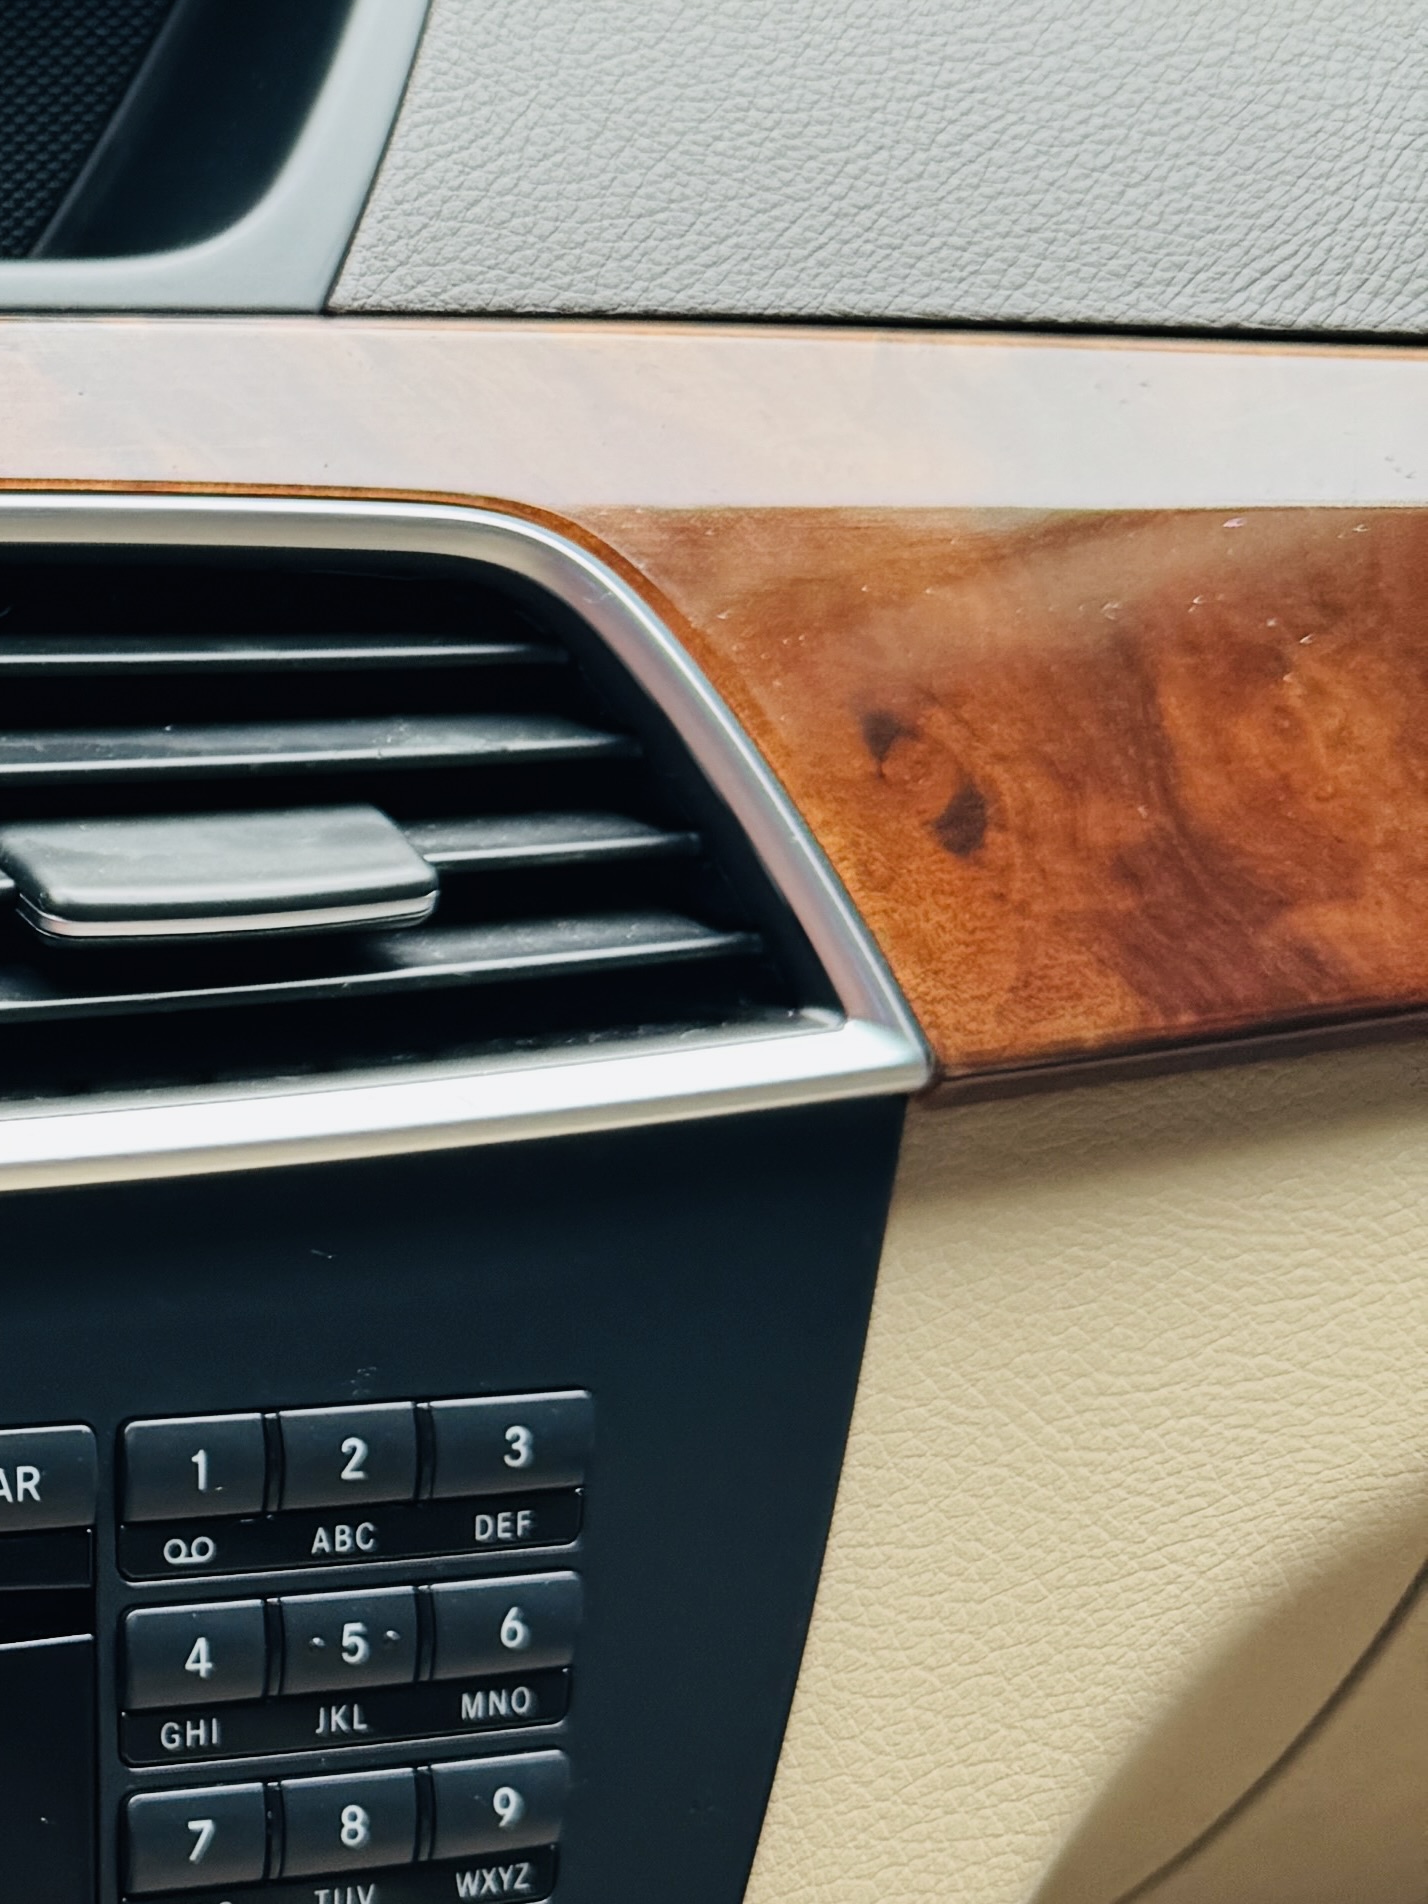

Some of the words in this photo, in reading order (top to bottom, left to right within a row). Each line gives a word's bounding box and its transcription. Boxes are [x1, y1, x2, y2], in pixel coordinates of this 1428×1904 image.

[341, 1437, 366, 1479] 2
[504, 1426, 531, 1467] 3
[192, 1450, 206, 1490] 1
[312, 1522, 374, 1553] ABC
[476, 1510, 531, 1540] DEF
[342, 1623, 368, 1663] 5
[501, 1607, 527, 1647] 6
[185, 1637, 212, 1677] 4
[316, 1704, 367, 1733] JKL
[462, 1687, 532, 1721] MNO
[161, 1718, 218, 1749] GHI
[341, 1805, 367, 1846] 8
[493, 1787, 521, 1826] 9
[188, 1820, 214, 1860] 7
[456, 1863, 530, 1897] WXYZ
